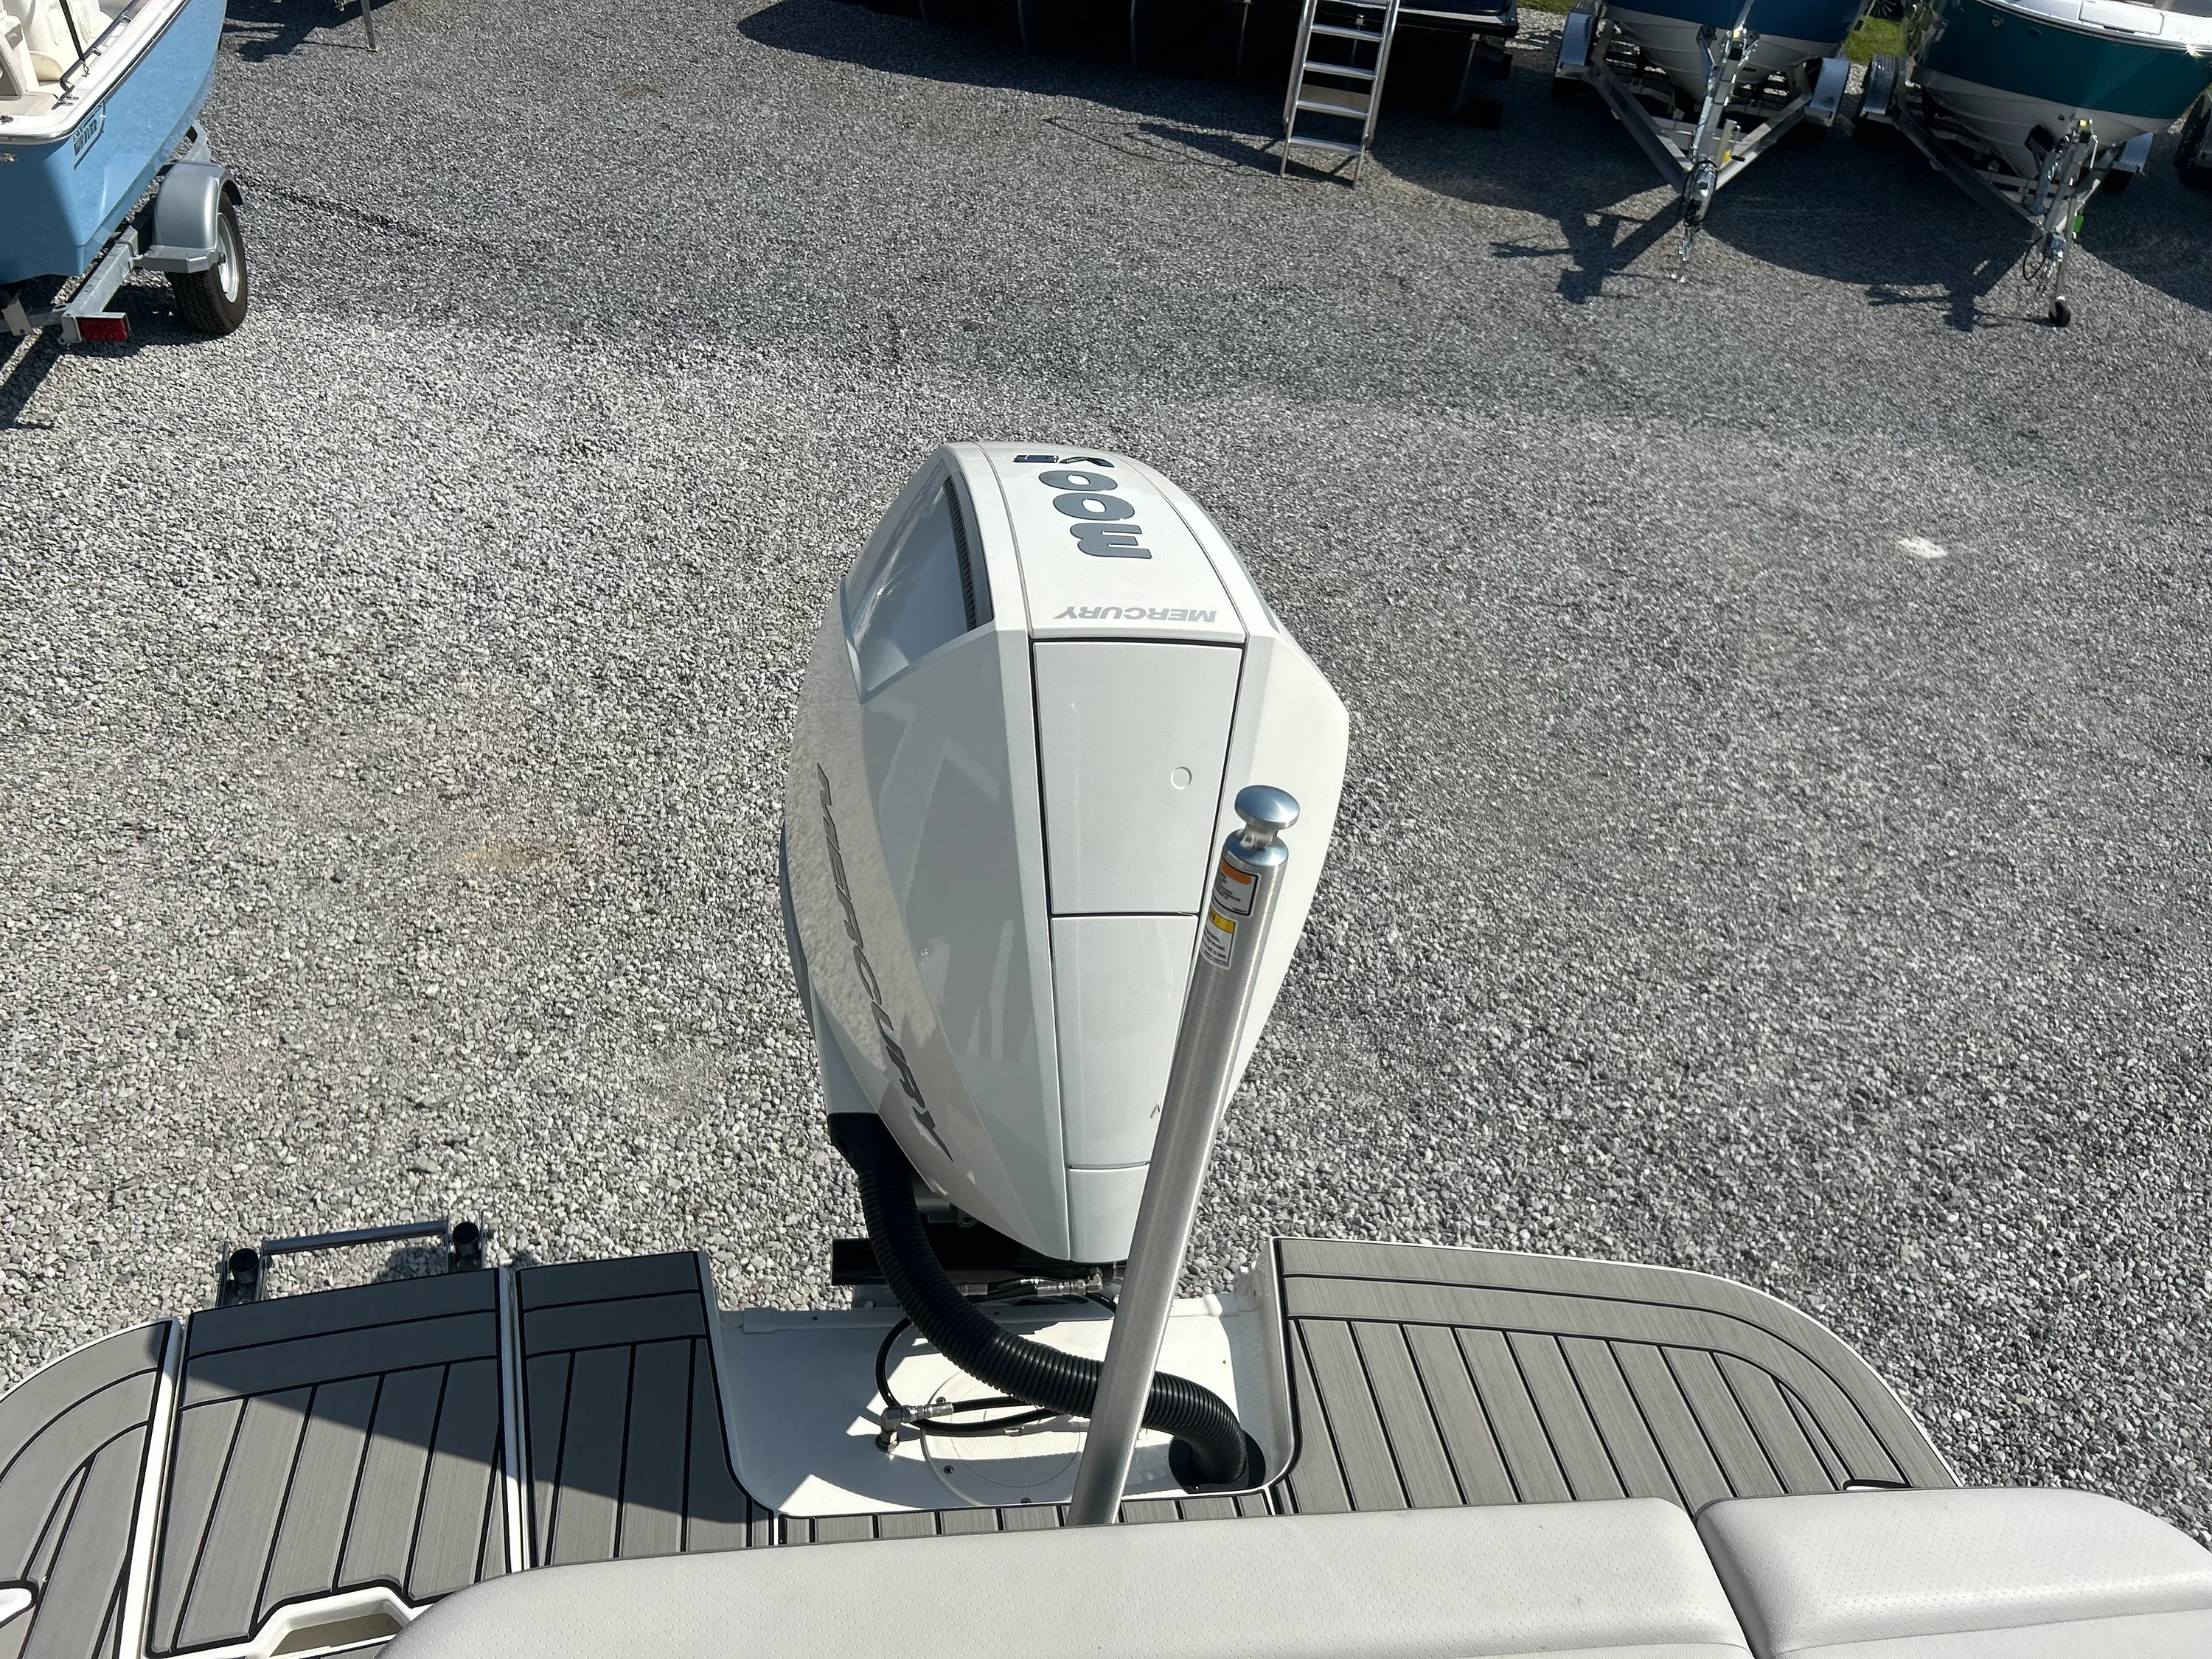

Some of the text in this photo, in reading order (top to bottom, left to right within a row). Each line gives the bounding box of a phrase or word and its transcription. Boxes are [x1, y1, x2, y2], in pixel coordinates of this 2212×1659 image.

[1037, 470, 1153, 560] 300
[1053, 605, 1218, 623] MERCURY
[816, 762, 954, 1163] MERCURY
